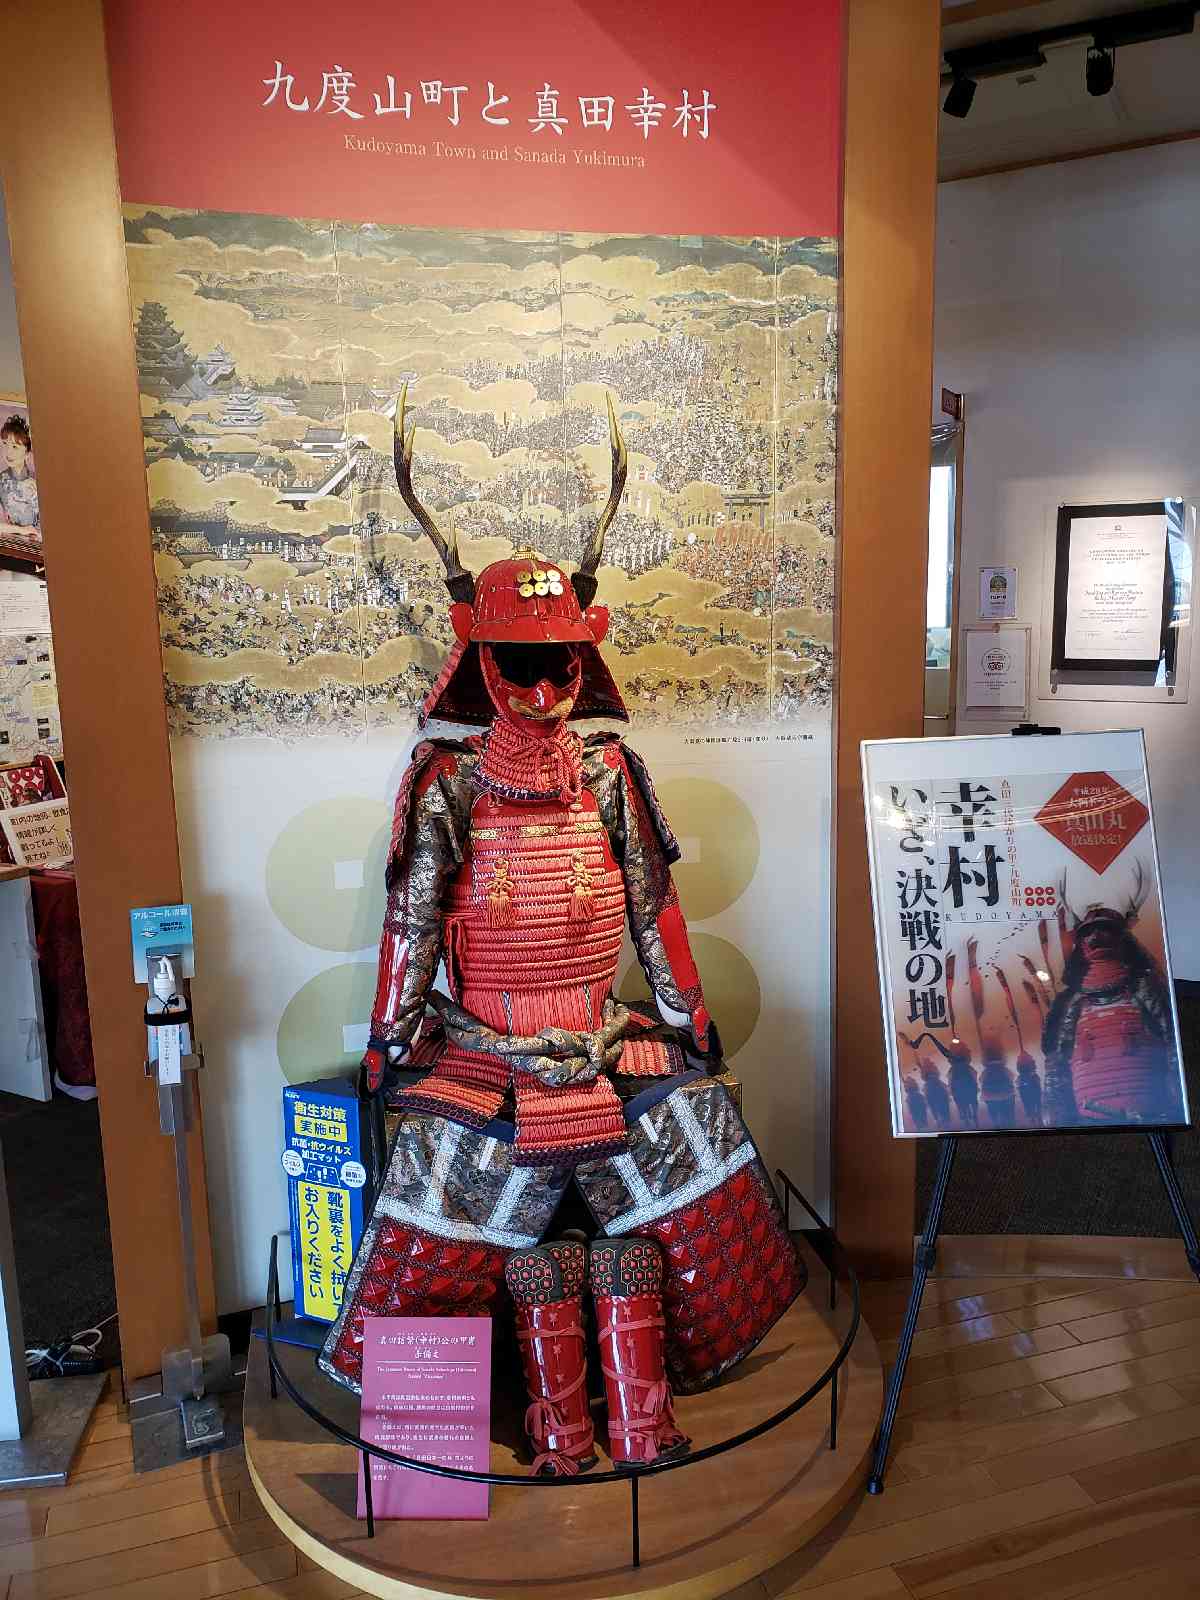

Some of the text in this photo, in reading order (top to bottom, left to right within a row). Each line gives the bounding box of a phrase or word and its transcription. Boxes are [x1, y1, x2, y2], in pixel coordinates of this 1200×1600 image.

[261, 59, 717, 140] 九度山町と真田幸村
[343, 134, 645, 168] Kudoyama Town and Sanada Yukimura
[935, 782, 1006, 909] 幸村
[294, 1101, 346, 1121] 衛生対策
[300, 1119, 341, 1137] 実施中
[304, 1186, 323, 1299] お入りください
[327, 1191, 347, 1306] 靴裏をよく拭い
